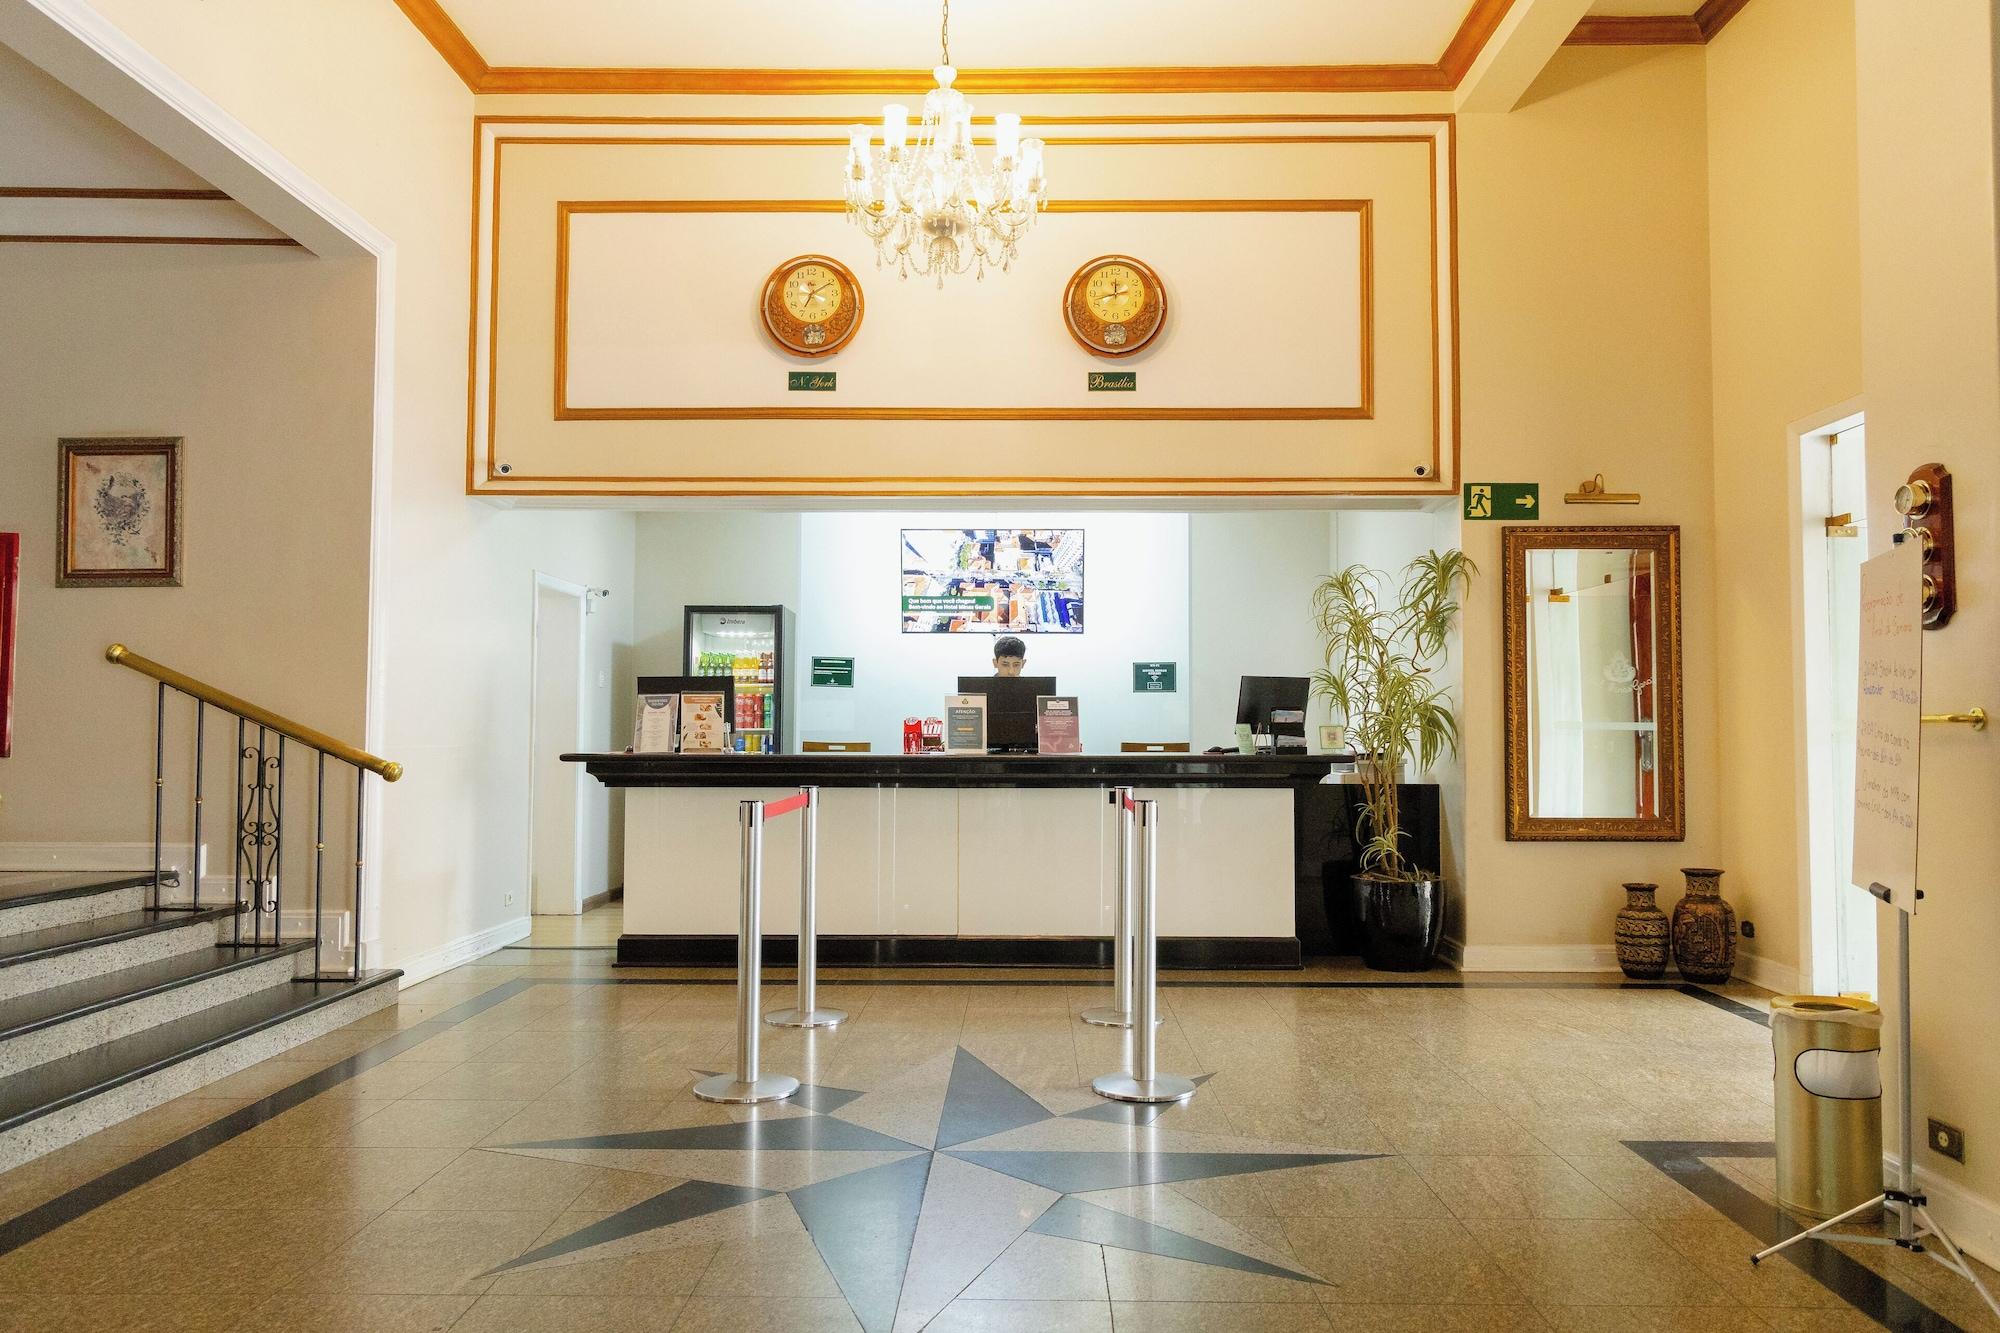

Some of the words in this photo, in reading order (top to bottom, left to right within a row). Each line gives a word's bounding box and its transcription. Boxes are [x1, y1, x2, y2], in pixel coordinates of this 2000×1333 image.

[797, 271, 805, 280] 11
[806, 267, 817, 276] 12
[1101, 271, 1109, 279] 11
[1110, 268, 1121, 276] 12
[789, 280, 799, 289] 10
[1092, 279, 1103, 287] 10
